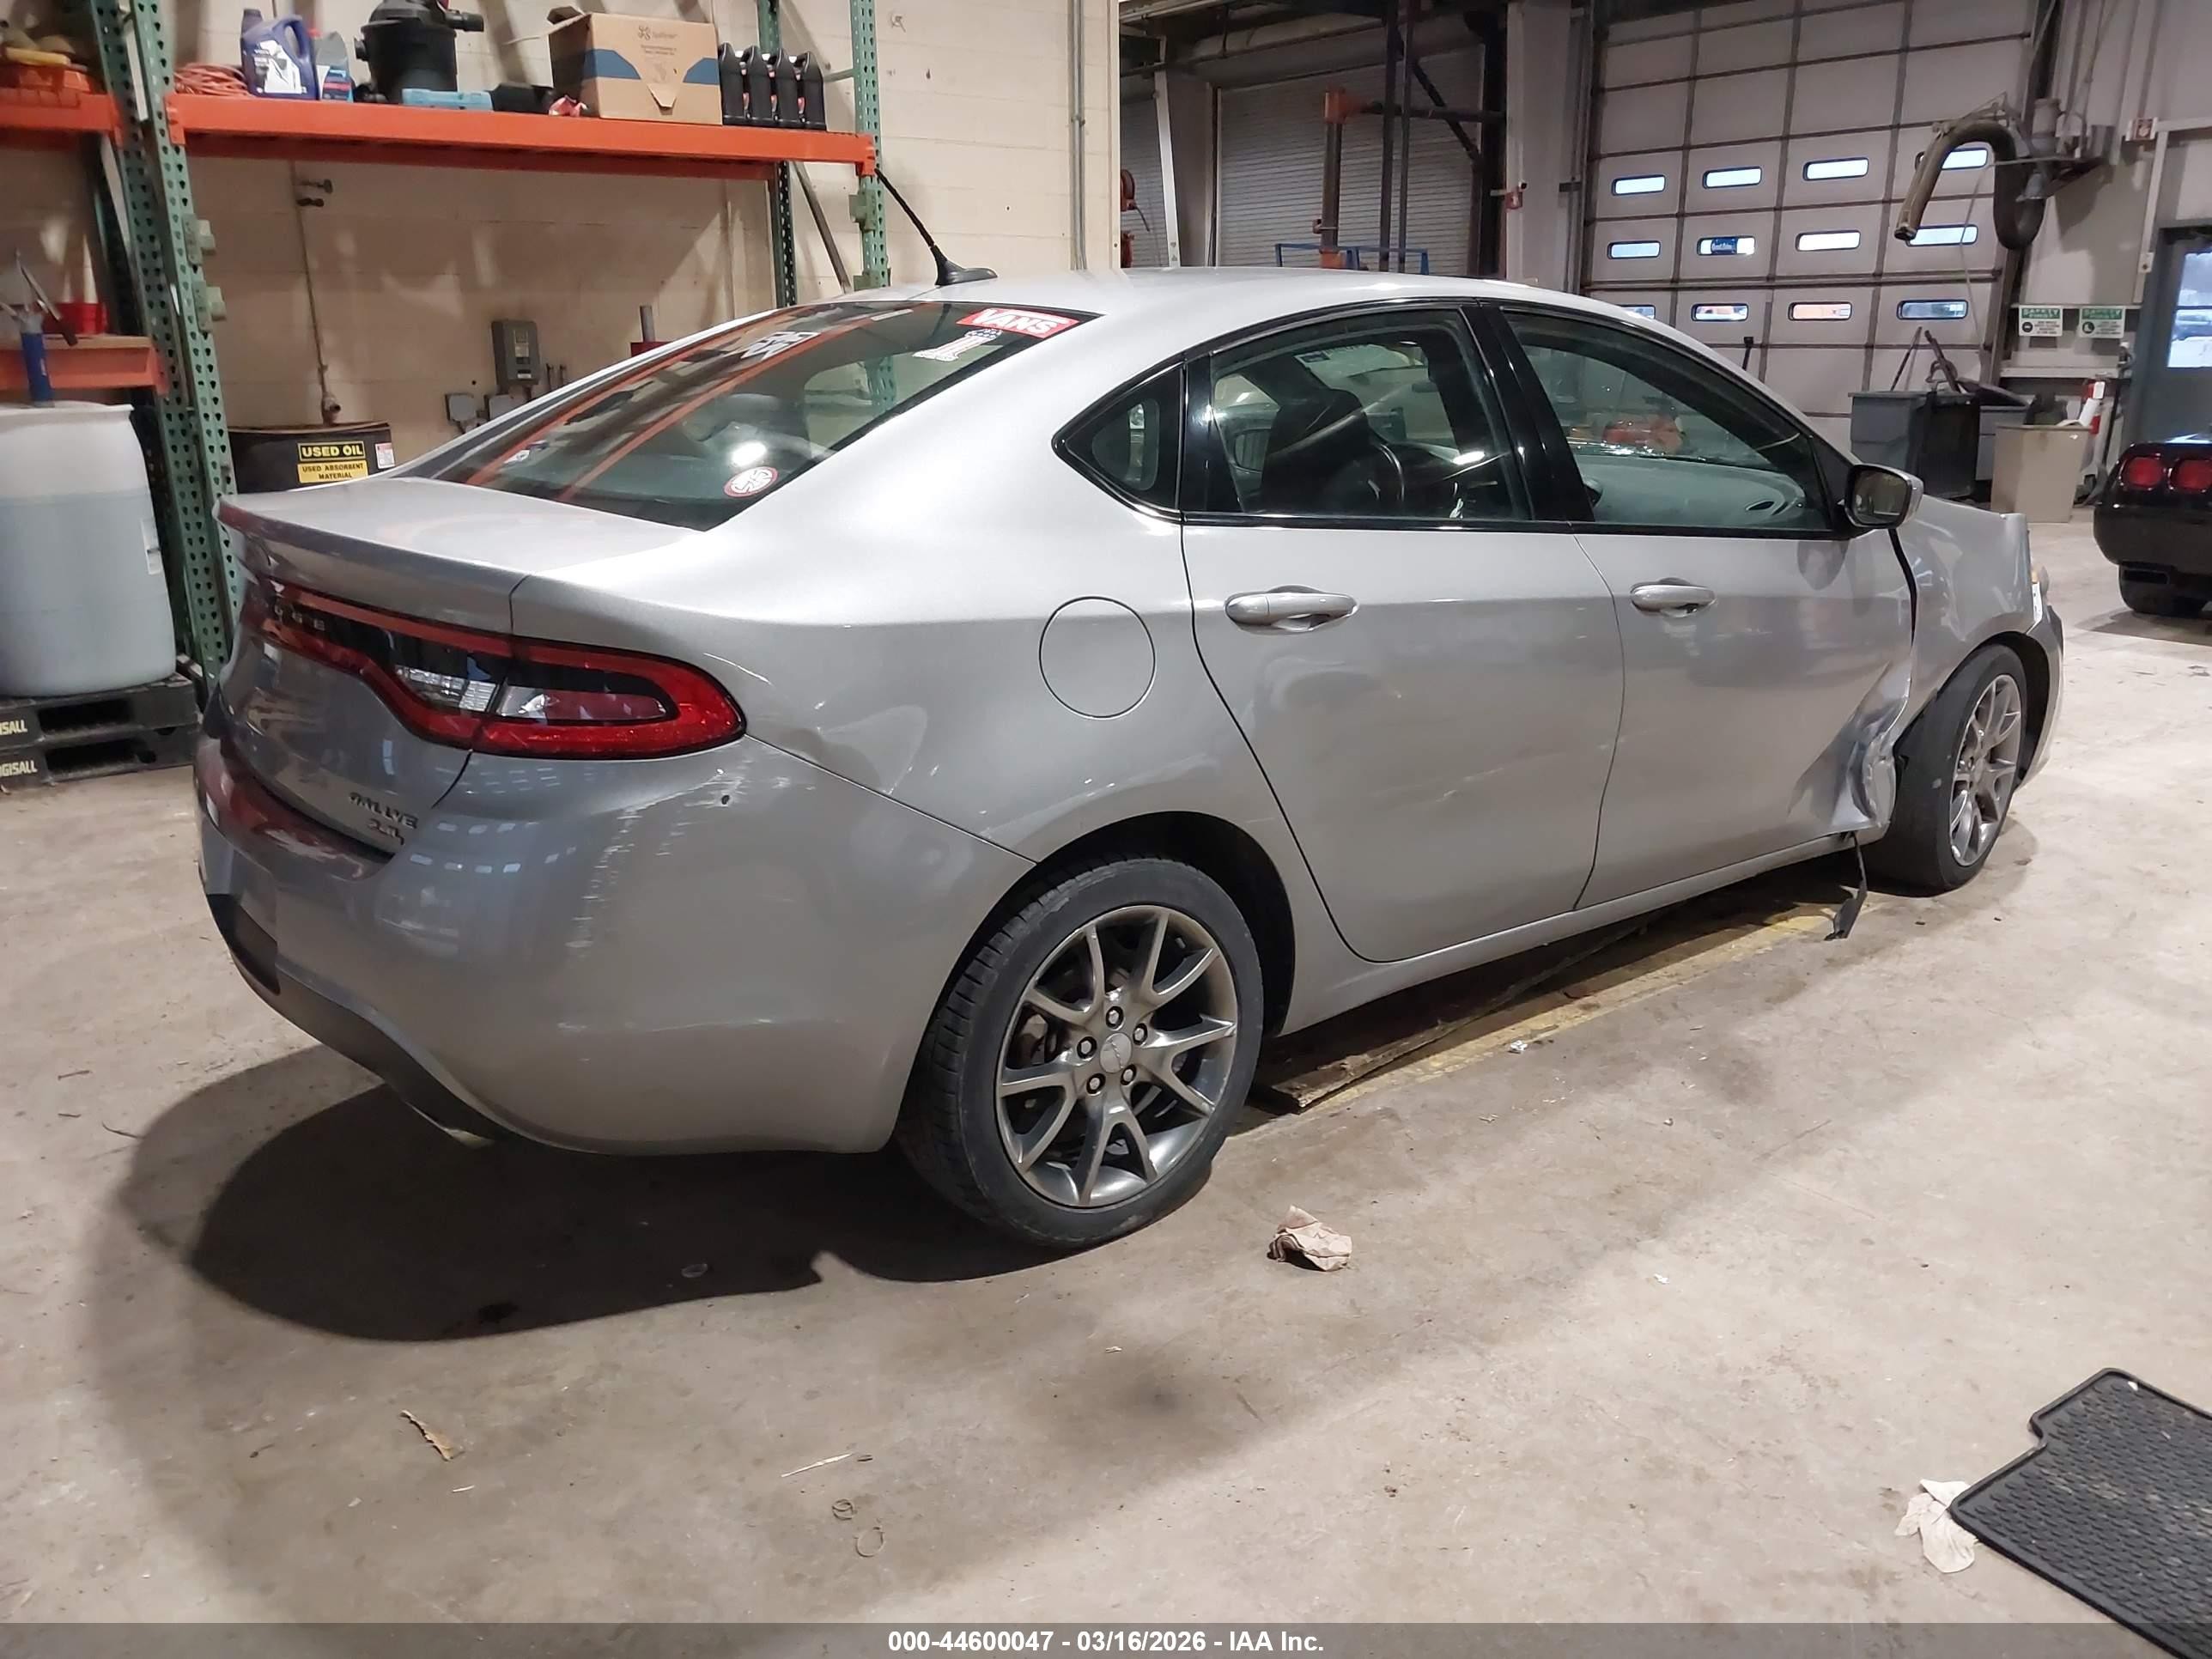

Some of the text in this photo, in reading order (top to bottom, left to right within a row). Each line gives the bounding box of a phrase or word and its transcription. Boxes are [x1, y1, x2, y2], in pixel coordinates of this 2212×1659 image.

[972, 308, 1071, 334] VANS
[301, 447, 340, 458] USED
[342, 445, 363, 456] OIL
[325, 463, 364, 472] ABSORBENT
[0, 760, 38, 777] GISALL
